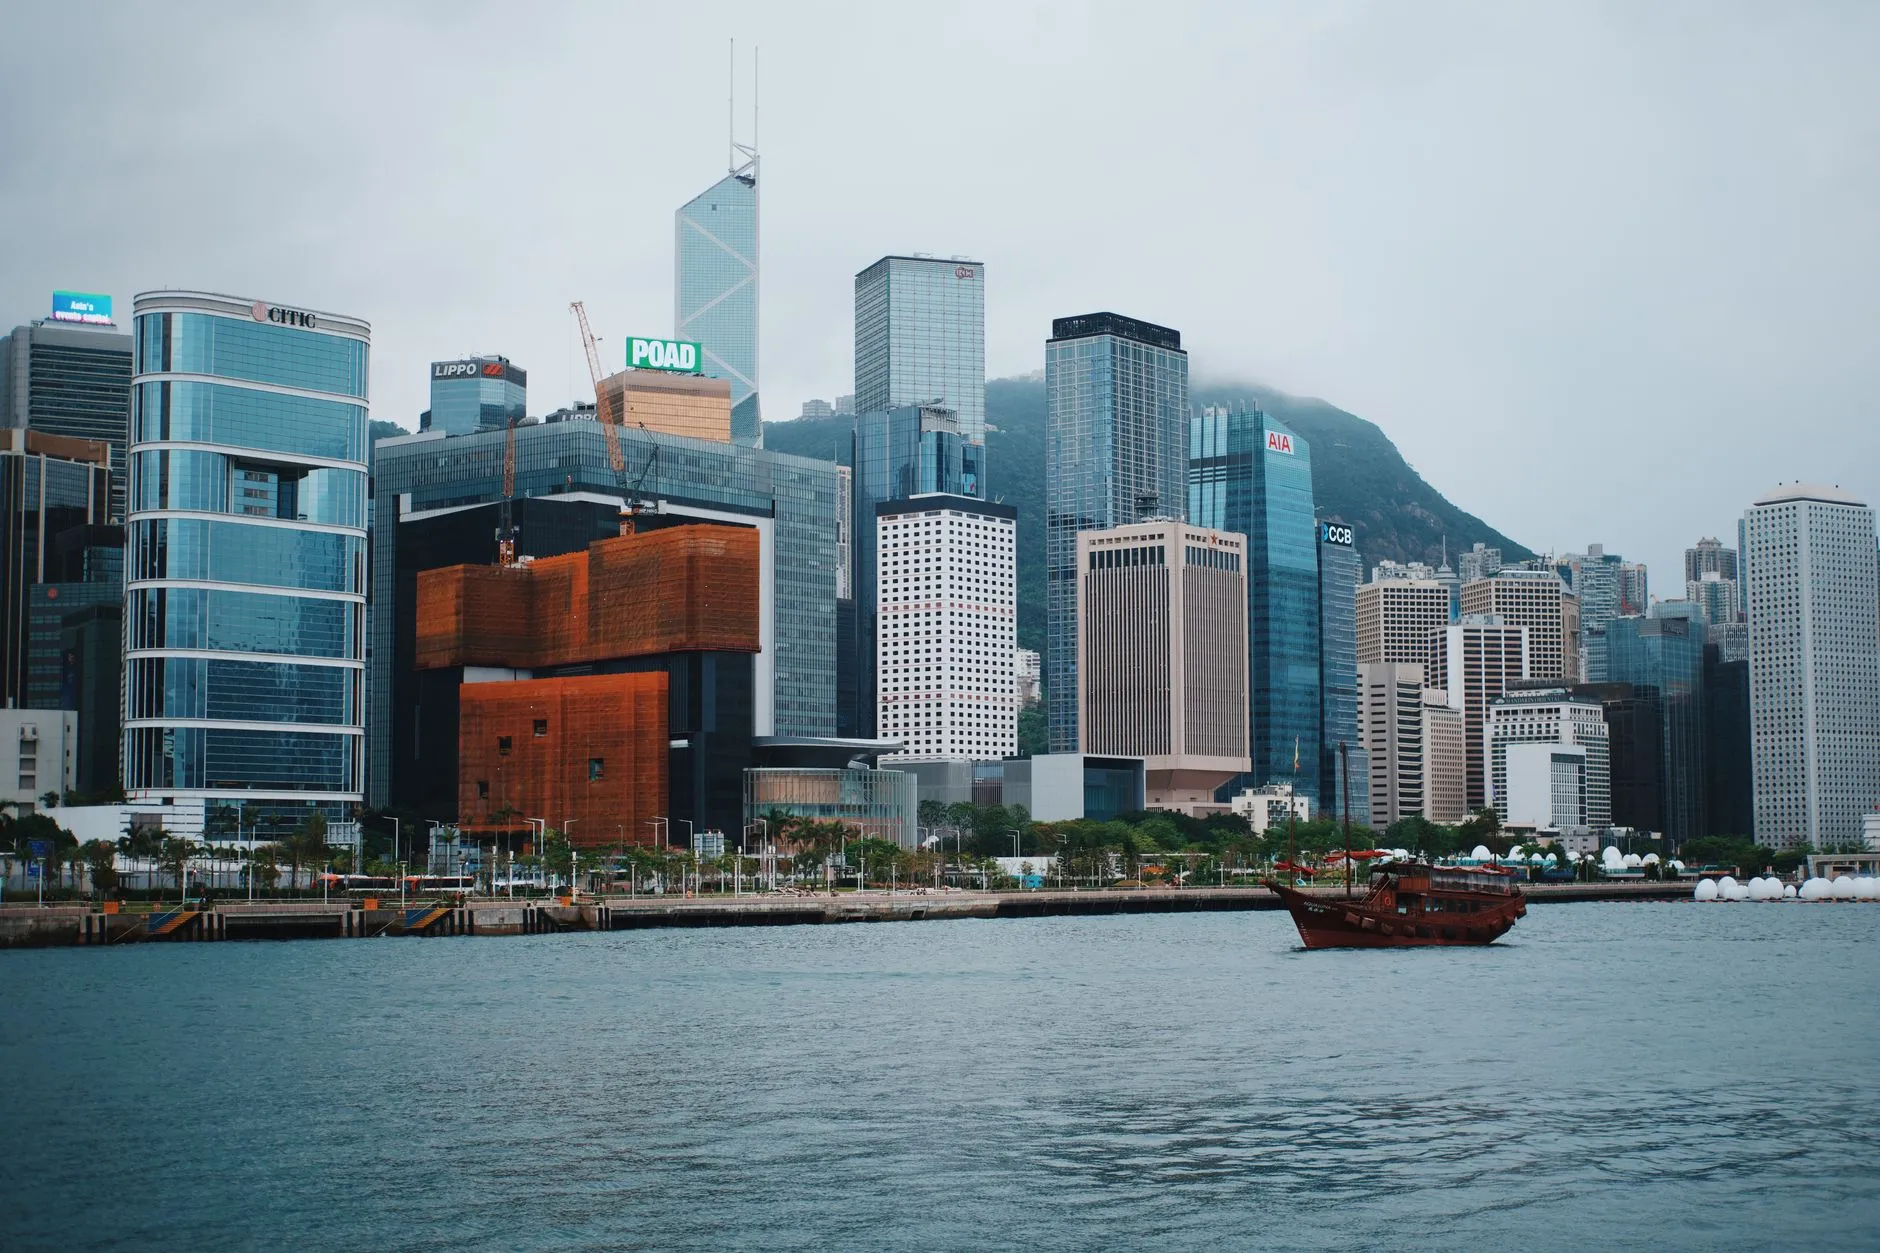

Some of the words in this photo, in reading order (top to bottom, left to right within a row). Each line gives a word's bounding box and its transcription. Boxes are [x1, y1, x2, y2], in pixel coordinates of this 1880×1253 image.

[269, 306, 316, 329] CITIC
[632, 339, 696, 369] POAD
[434, 363, 477, 377] LIPPO
[1268, 432, 1291, 453] AIA
[1328, 525, 1352, 544] CCB
